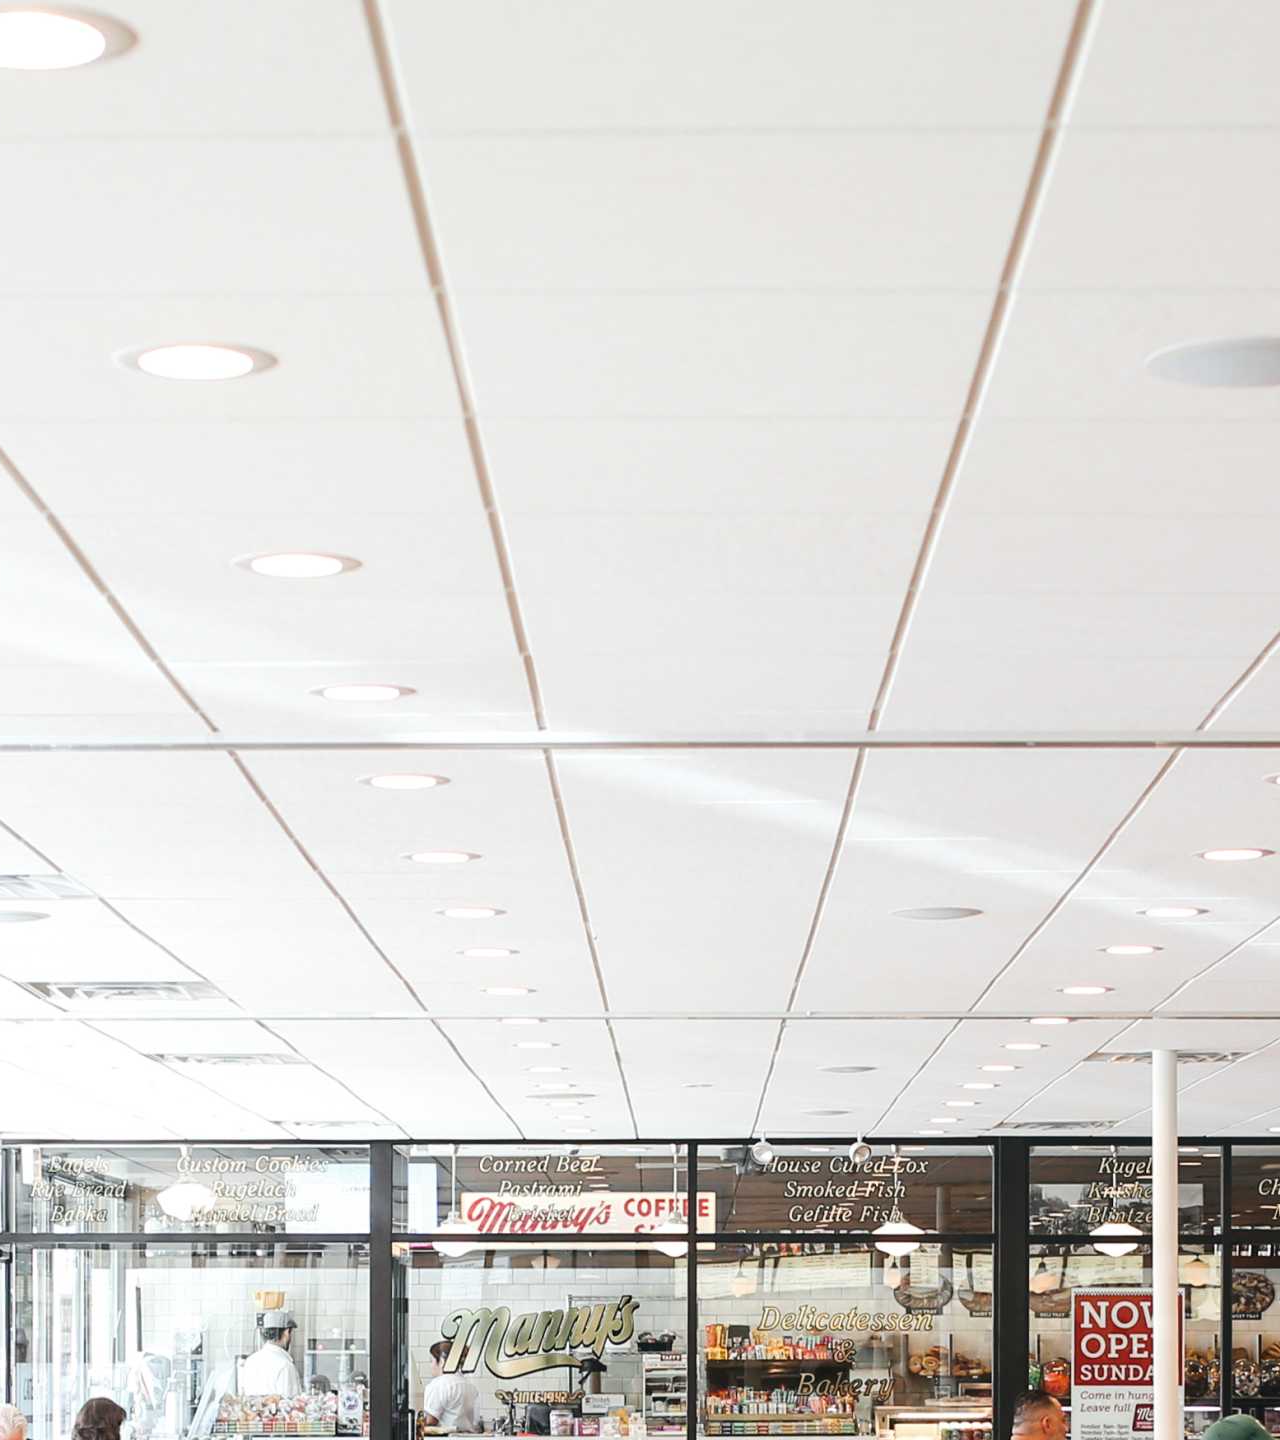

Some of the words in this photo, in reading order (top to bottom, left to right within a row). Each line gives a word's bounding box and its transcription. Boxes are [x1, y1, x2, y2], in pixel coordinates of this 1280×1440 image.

[48, 1155, 111, 1175] Bagels
[176, 1155, 247, 1173] Custom
[254, 1155, 329, 1173] Cookies
[479, 1155, 549, 1173] Corned
[556, 1155, 600, 1173] Beef
[763, 1157, 821, 1173] House
[829, 1156, 885, 1173] Cured
[891, 1157, 929, 1173] Lox
[1099, 1157, 1153, 1177] Kugel
[31, 1180, 64, 1200] Rye
[71, 1180, 127, 1198] Bread
[212, 1180, 297, 1200] Rugelach
[499, 1180, 584, 1198] Pastrami
[784, 1180, 859, 1198] Smoked
[863, 1181, 906, 1198] Fish
[1089, 1181, 1152, 1199] Knishe
[50, 1204, 108, 1222] Babka
[263, 1204, 321, 1222] Bread
[507, 1204, 576, 1222] Brisket
[788, 1205, 853, 1222] Gefilte
[860, 1205, 904, 1223] Fish
[1088, 1206, 1152, 1223] Blintze
[757, 1304, 934, 1332] Delicatessen
[440, 1294, 640, 1380] Manny's
[1080, 1333, 1154, 1359] OPE
[833, 1339, 855, 1363] &
[1080, 1364, 1154, 1381] SUNDA
[796, 1372, 897, 1402] Bakery
[1080, 1390, 1112, 1400] Come
[1114, 1390, 1125, 1400] in
[513, 1391, 541, 1404] SINCE
[543, 1391, 568, 1404] 1942
[1080, 1403, 1111, 1413] Leave
